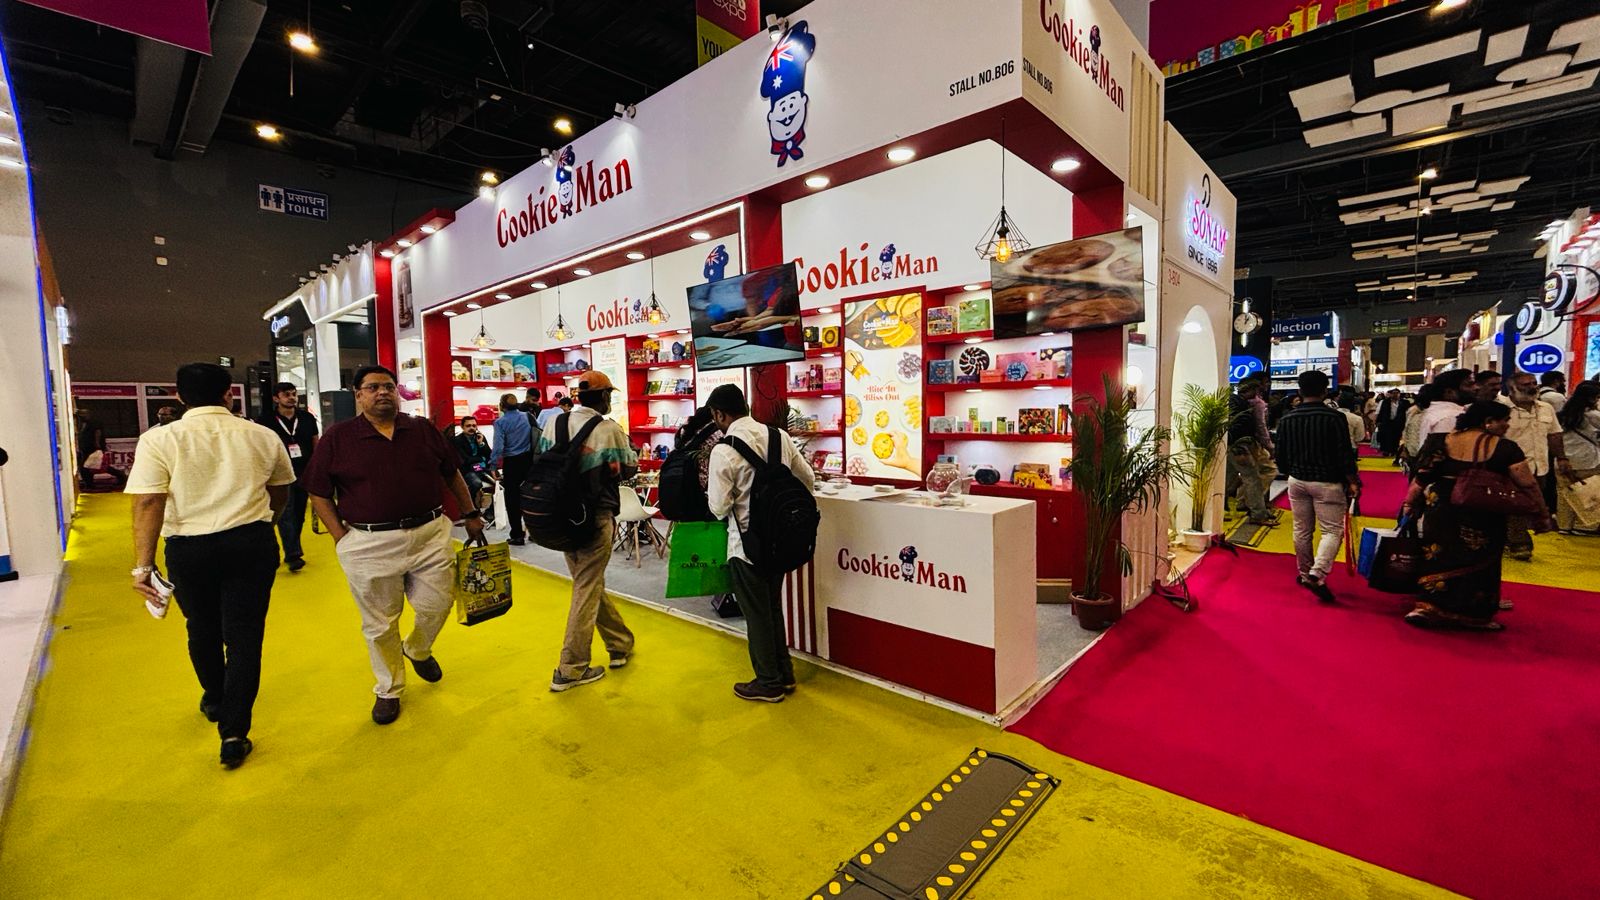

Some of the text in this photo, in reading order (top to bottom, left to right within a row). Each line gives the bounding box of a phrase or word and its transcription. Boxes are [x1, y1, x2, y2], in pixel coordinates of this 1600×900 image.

[1040, 0, 1124, 112] Cookie Man
[1022, 57, 1037, 81] STALL
[949, 76, 977, 97] STALL
[287, 203, 325, 217] TOILET
[496, 158, 633, 248] Cookie Man
[894, 253, 938, 279] Man
[1188, 244, 1204, 266] SINCE
[587, 297, 634, 332] Cookie
[1523, 351, 1559, 366] Jio
[837, 548, 967, 593] Cookie Man
